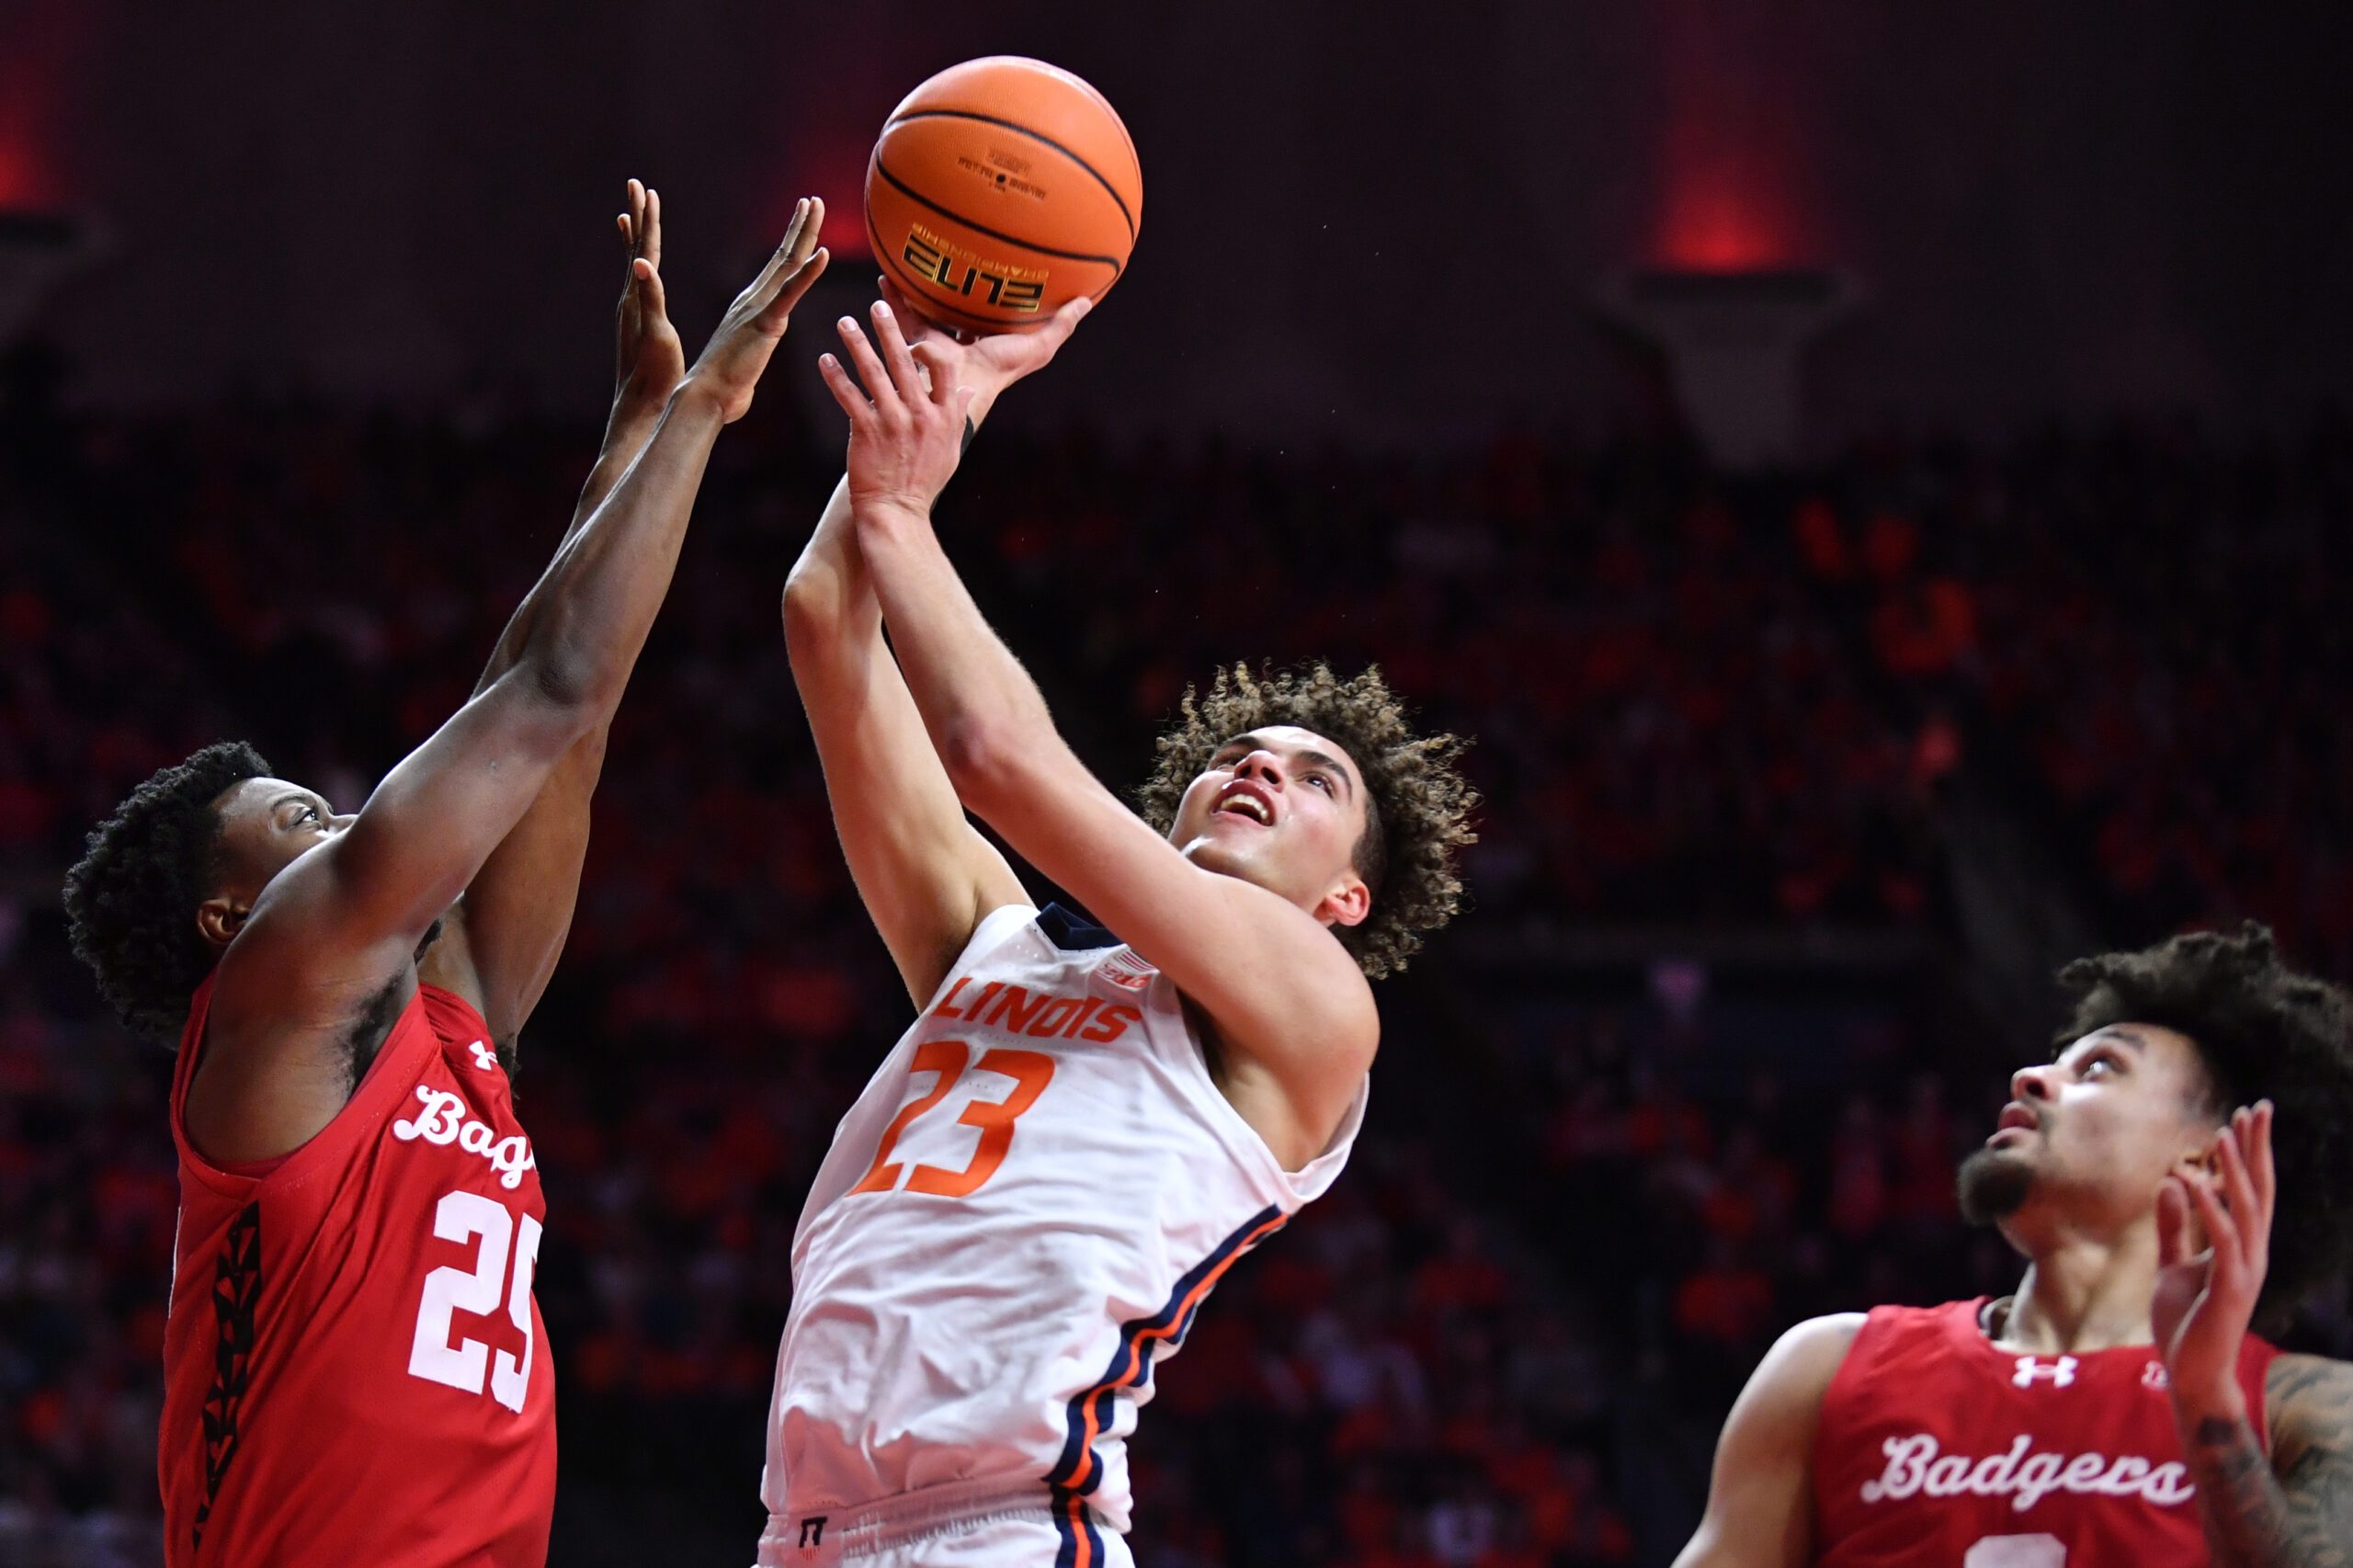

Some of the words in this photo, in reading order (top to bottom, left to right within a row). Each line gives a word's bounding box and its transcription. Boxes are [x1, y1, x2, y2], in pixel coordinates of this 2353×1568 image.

[902, 230, 1047, 312] ELITE
[912, 222, 1050, 279] CHAMPIONSHIP
[843, 1040, 1056, 1198] 23
[407, 1190, 542, 1415] 25
[1860, 1434, 2196, 1512] Badgers
